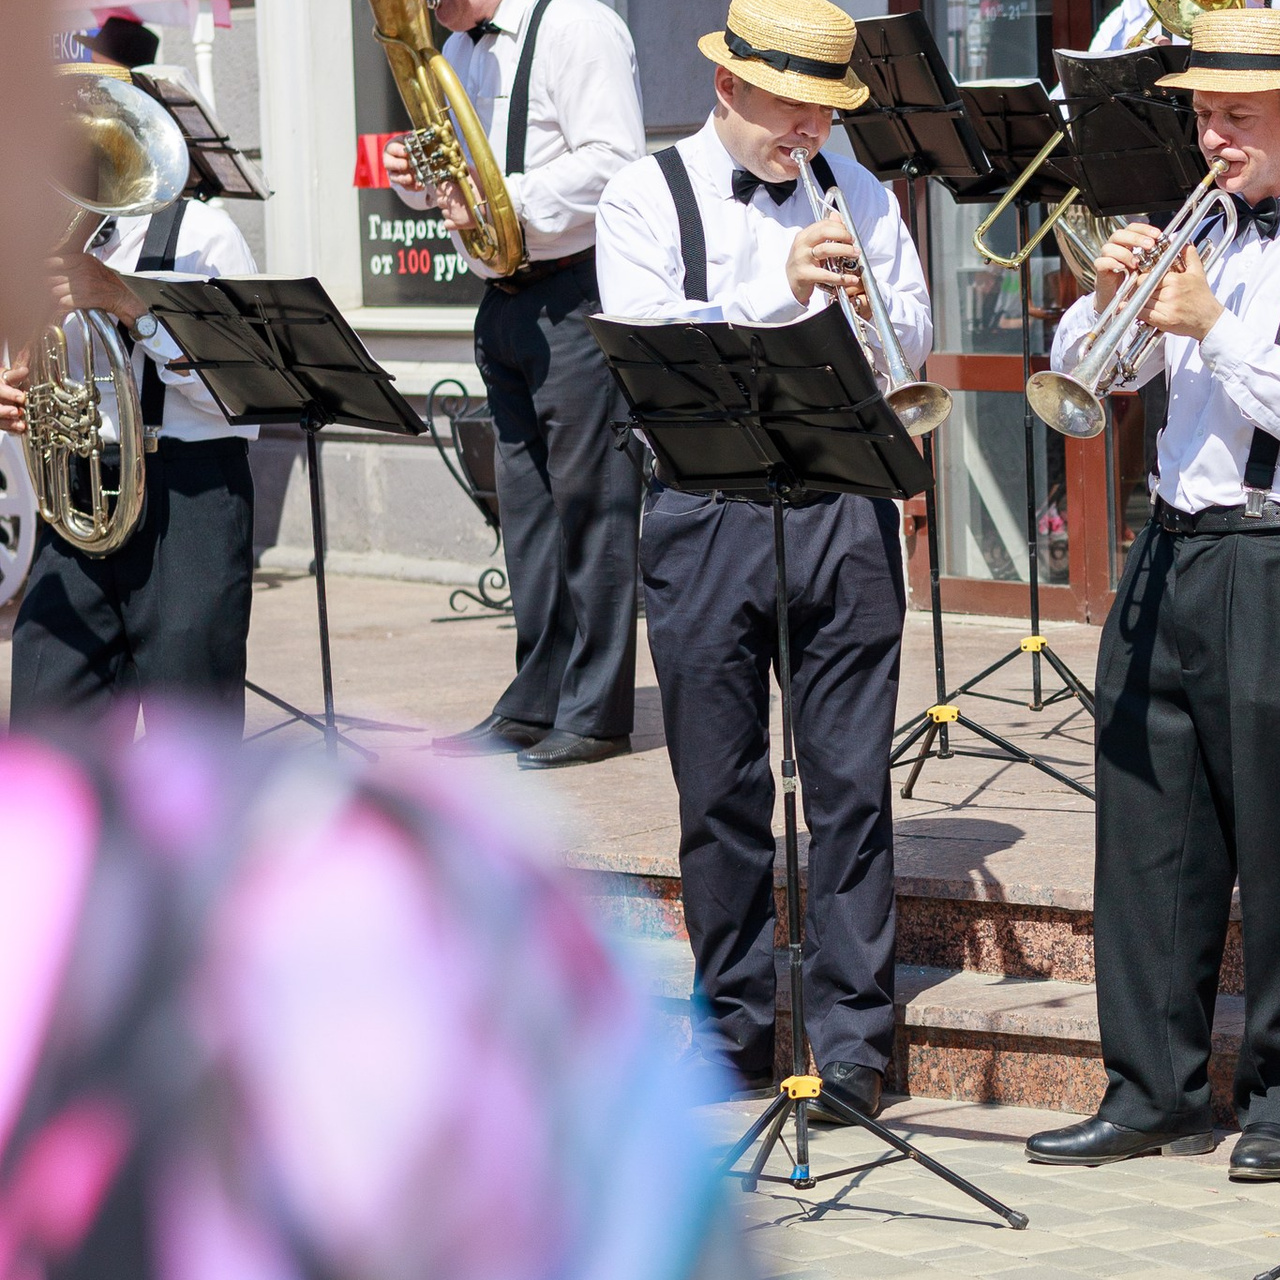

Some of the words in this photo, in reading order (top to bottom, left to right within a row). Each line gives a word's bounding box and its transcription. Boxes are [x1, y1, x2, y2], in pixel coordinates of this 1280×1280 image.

[48, 28, 88, 60] ЕКОР
[368, 214, 451, 246] Гидроге
[370, 253, 393, 275] от
[397, 248, 431, 275] 100
